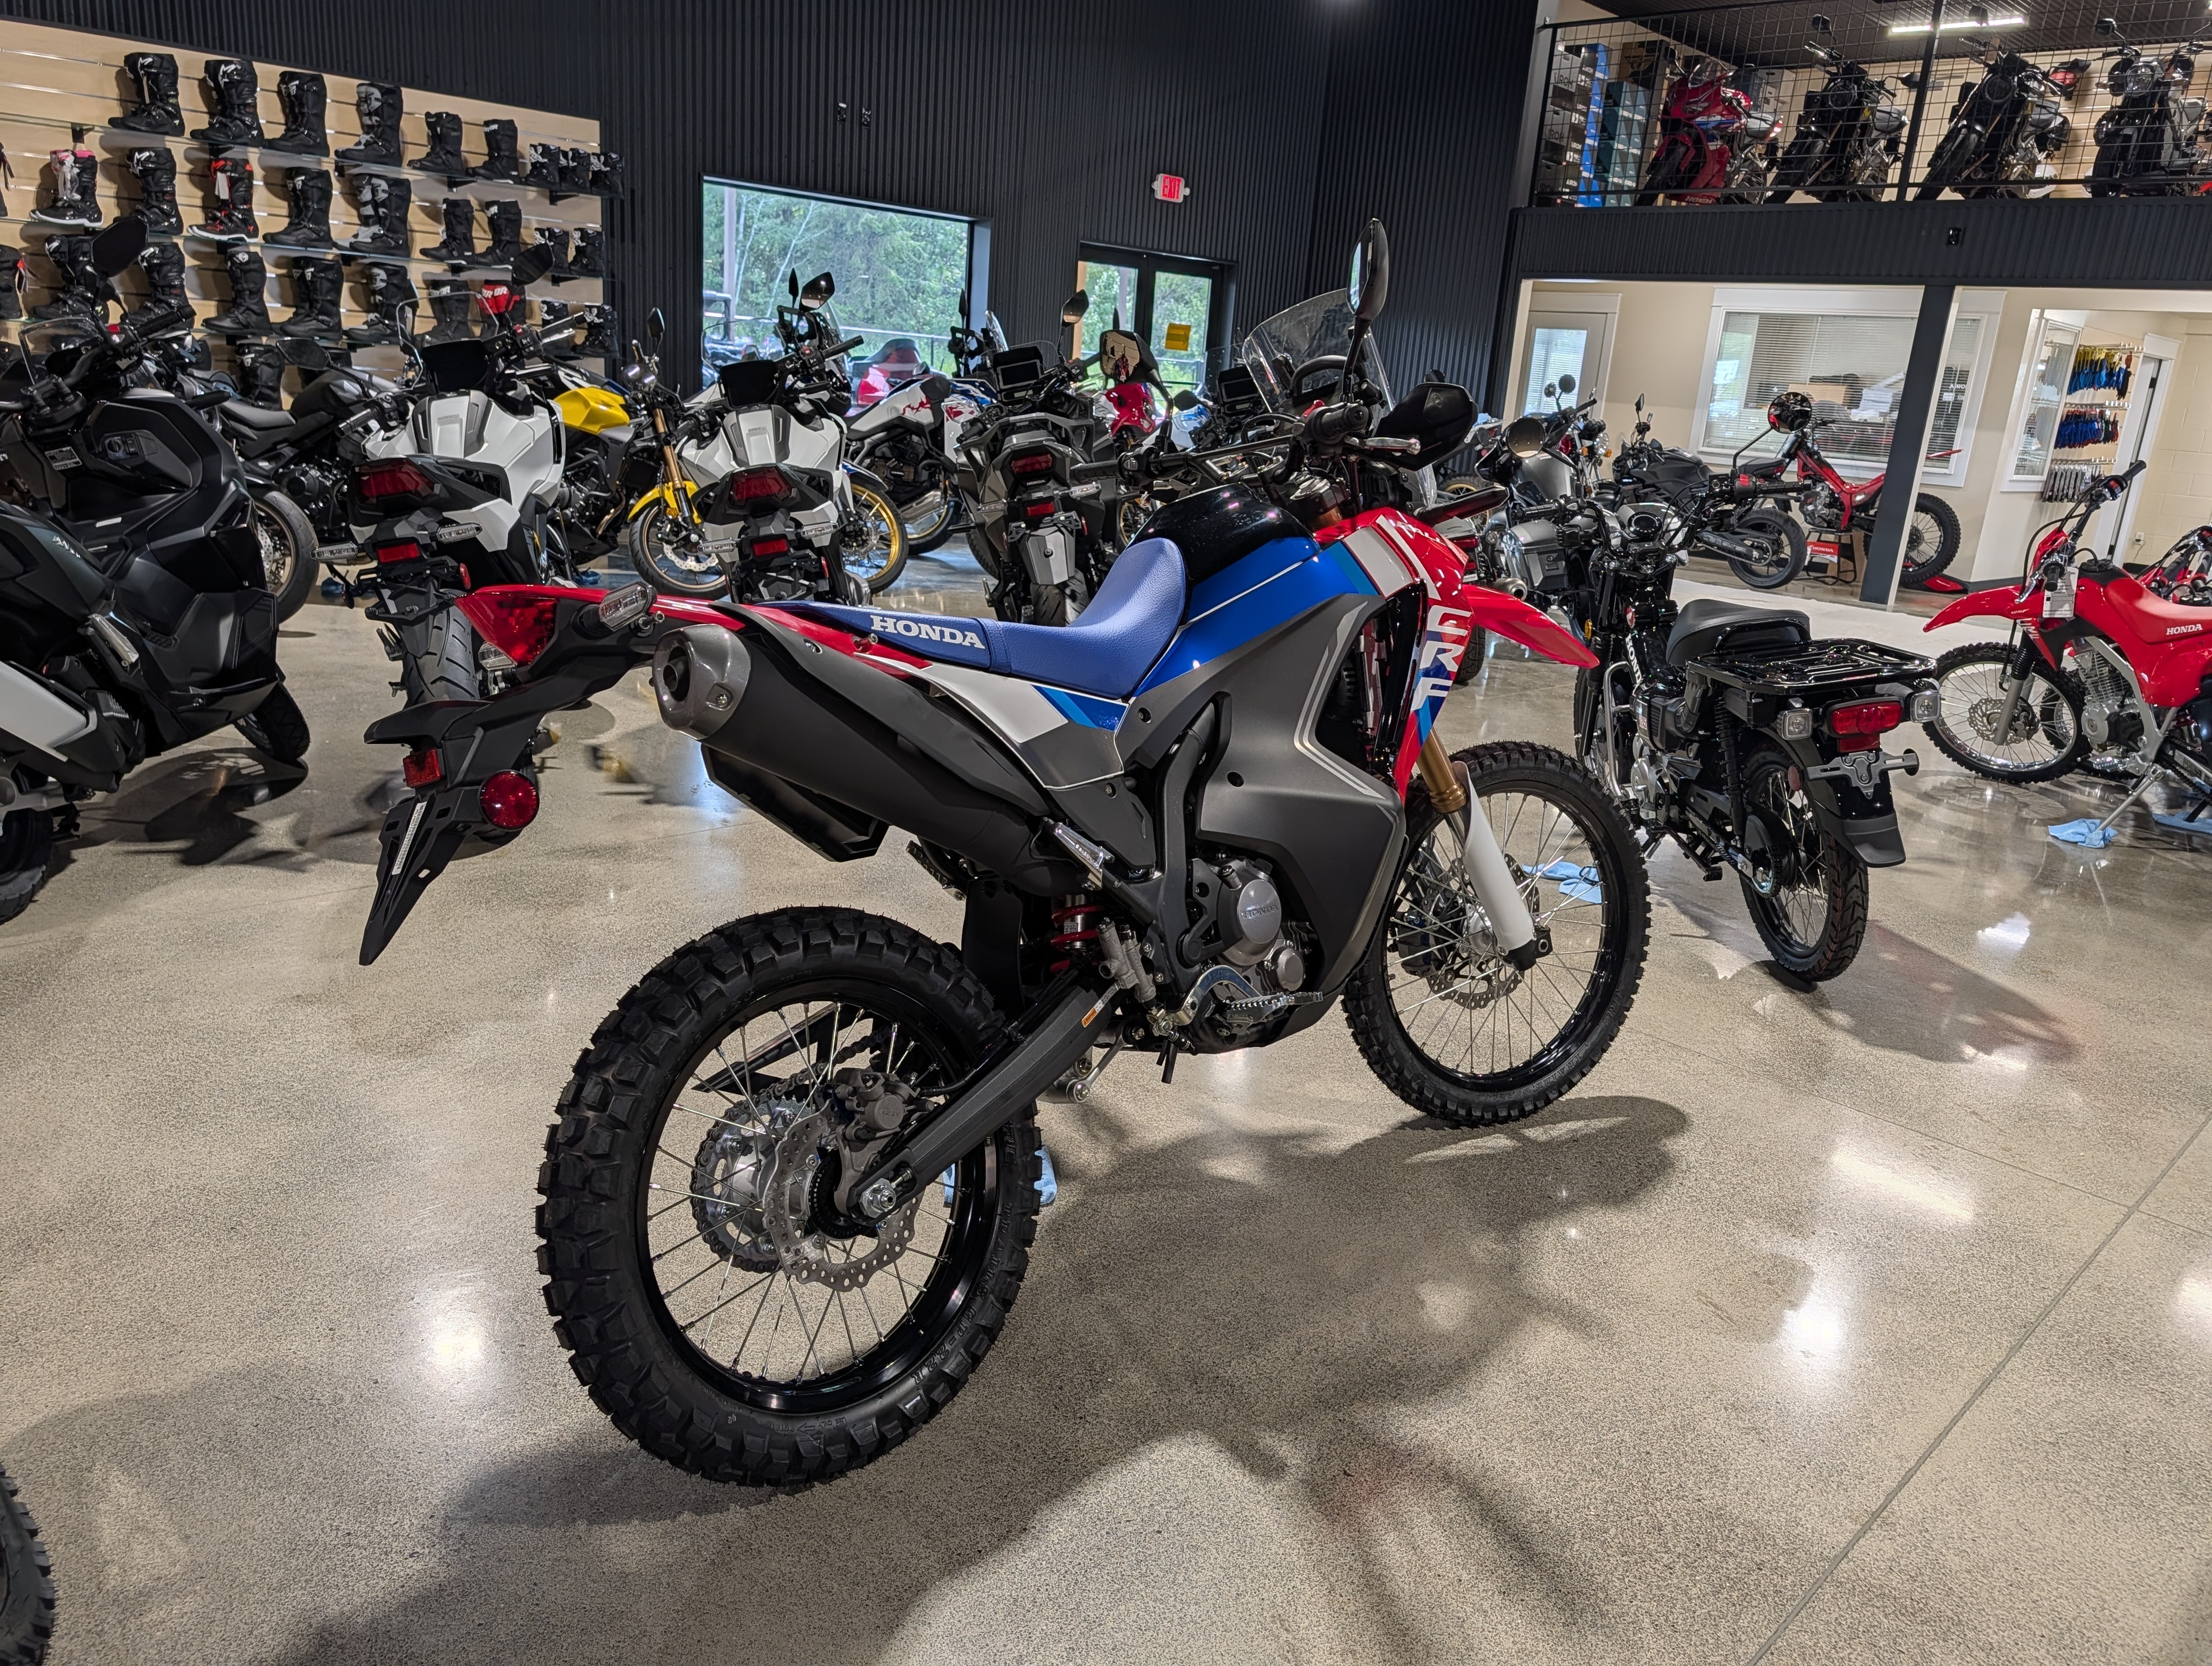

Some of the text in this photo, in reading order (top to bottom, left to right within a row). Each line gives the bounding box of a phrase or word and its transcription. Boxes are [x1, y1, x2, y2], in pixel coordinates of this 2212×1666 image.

[1162, 175, 1182, 200] EXIT
[1396, 521, 1446, 547] RALL
[870, 614, 986, 650] HONDA
[2165, 624, 2203, 636] HONDA
[1411, 604, 1471, 712] CRF
[1625, 633, 1643, 684] HOND
[1242, 905, 1279, 918] HONDA
[1534, 1052, 1584, 1092] TRAILS
[912, 1202, 1013, 1387] TRAILS GP-22R
